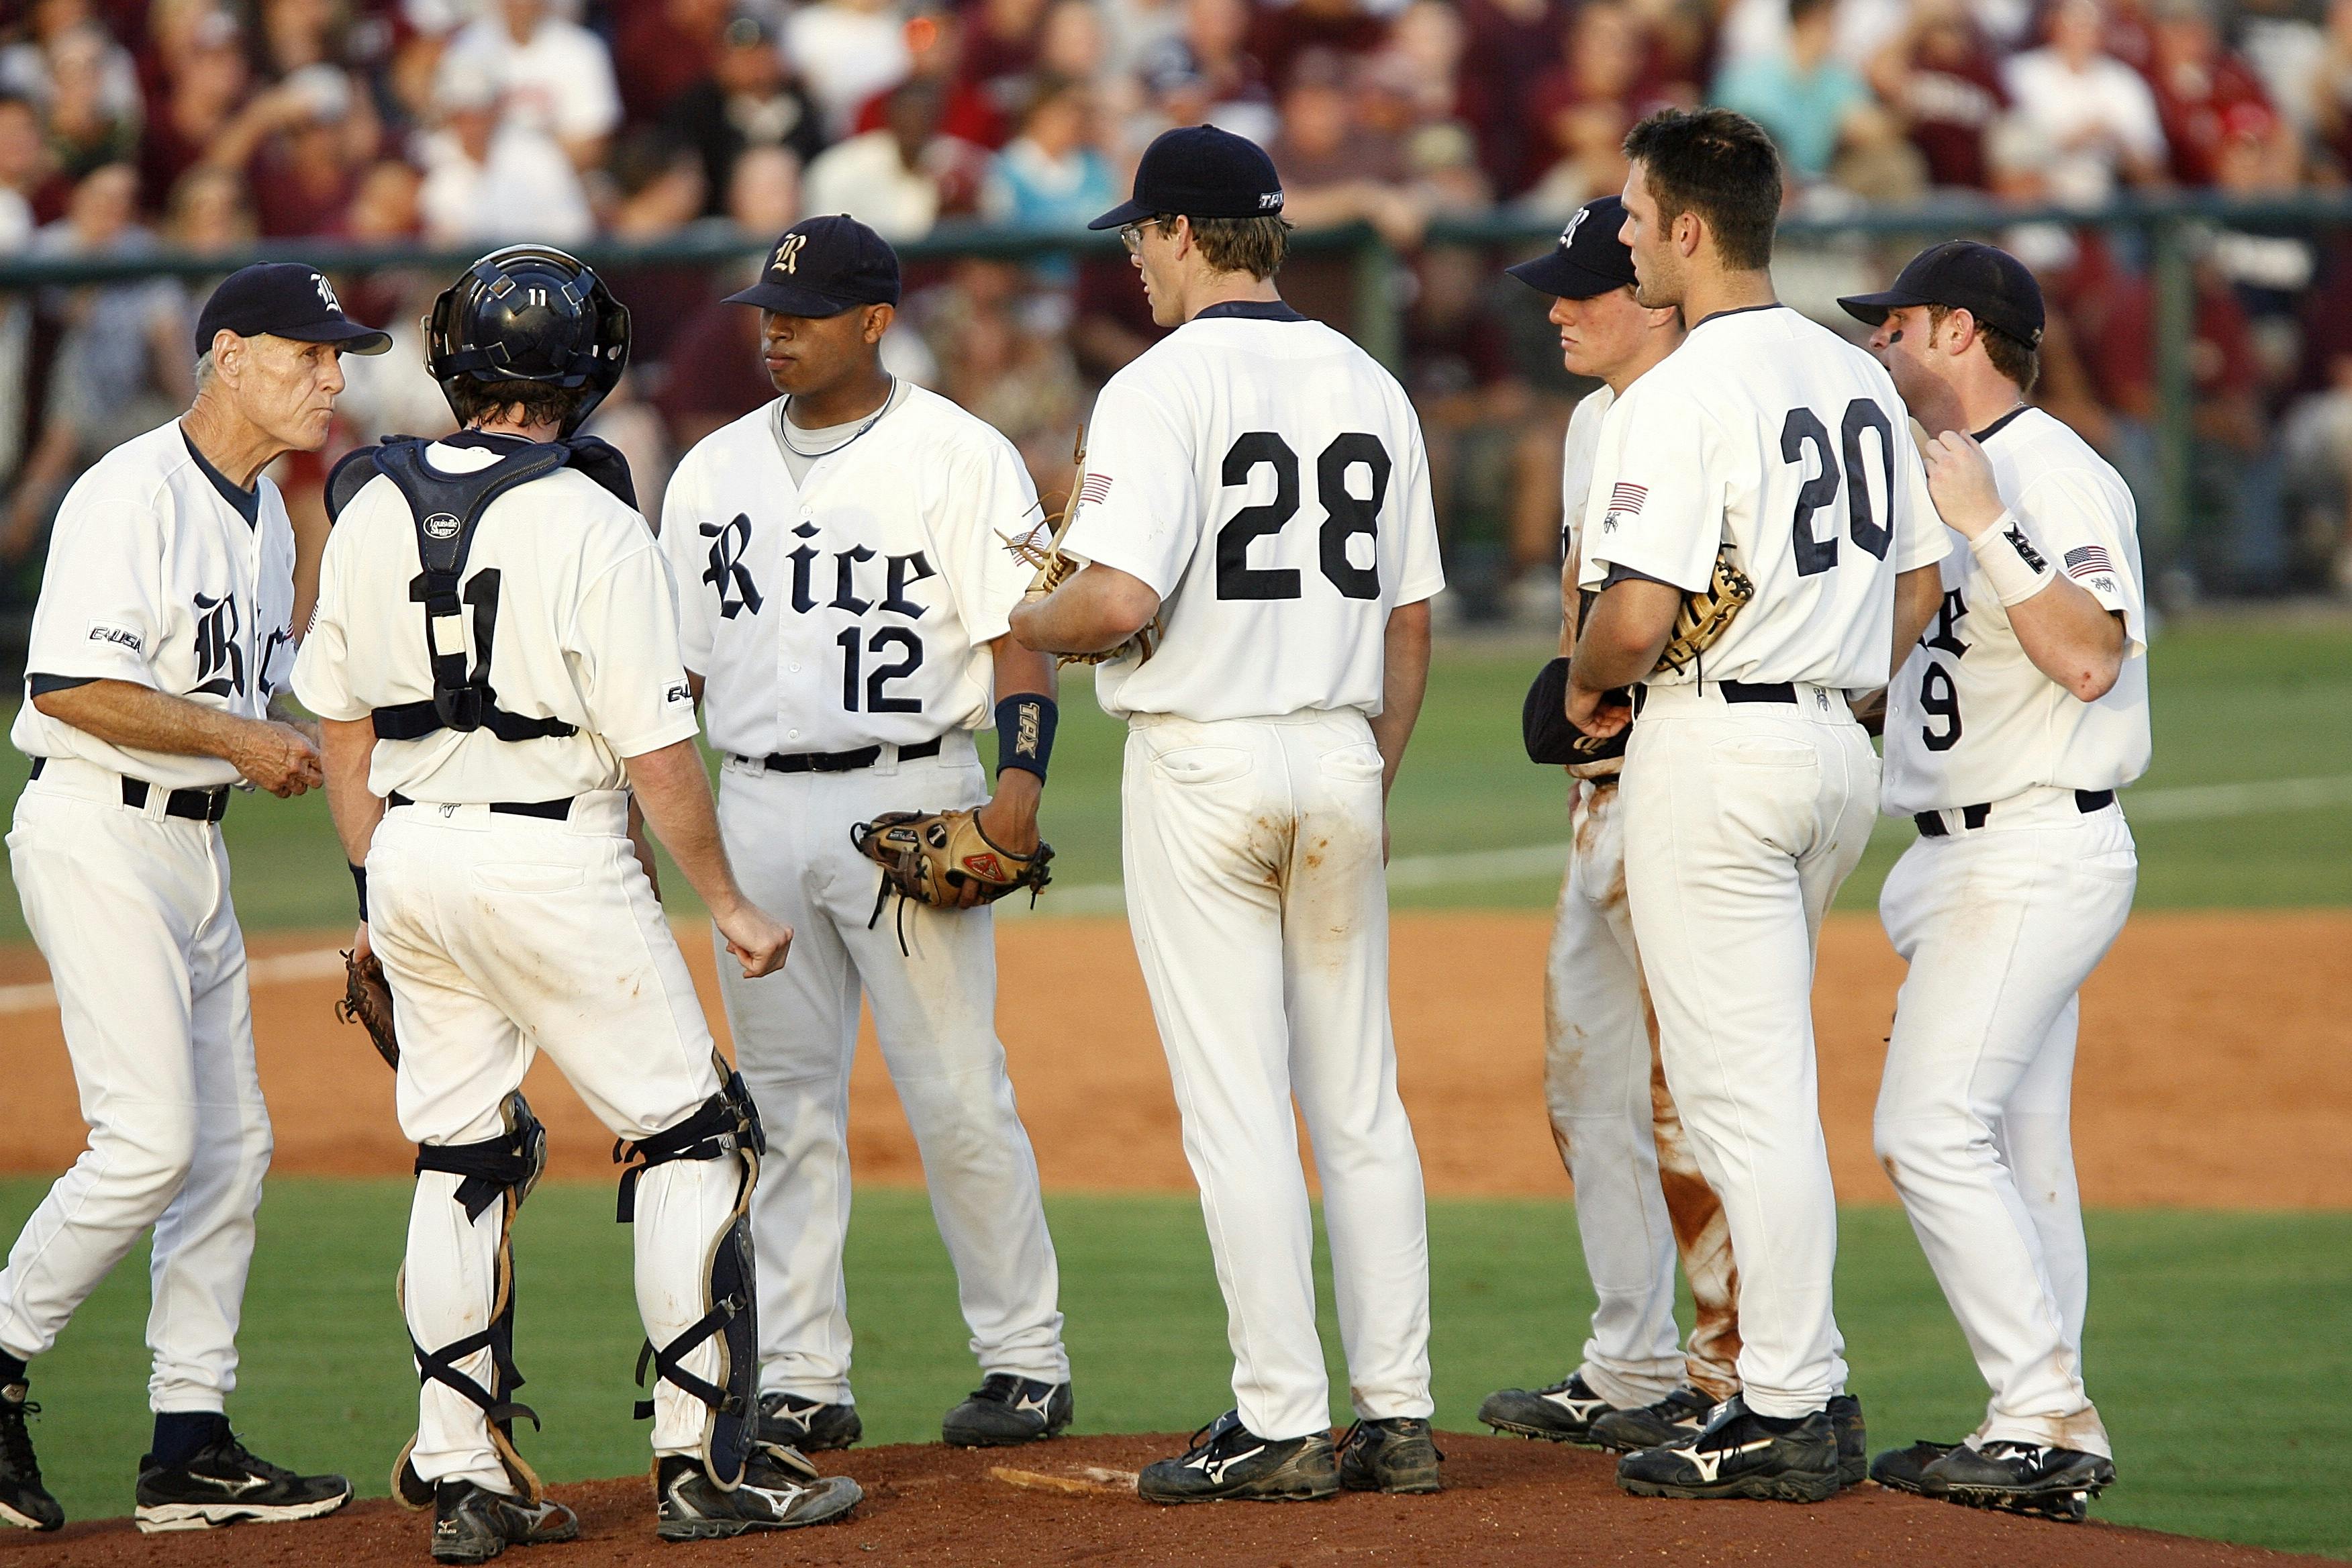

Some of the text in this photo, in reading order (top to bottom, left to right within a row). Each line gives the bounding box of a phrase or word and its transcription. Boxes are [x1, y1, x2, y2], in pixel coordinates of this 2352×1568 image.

[771, 233, 806, 274] R
[1560, 207, 1589, 248] R
[311, 274, 343, 313] R
[529, 289, 546, 306] 11
[1781, 398, 1894, 577] 20
[430, 519, 457, 527] Louisville
[430, 526, 455, 536] Slugger
[1216, 432, 1392, 600] 28
[699, 512, 937, 620] Rice
[2002, 522, 2049, 575] TPX
[836, 626, 924, 714] 12
[1016, 702, 1040, 759] TPX
[1920, 662, 1962, 752] 9
